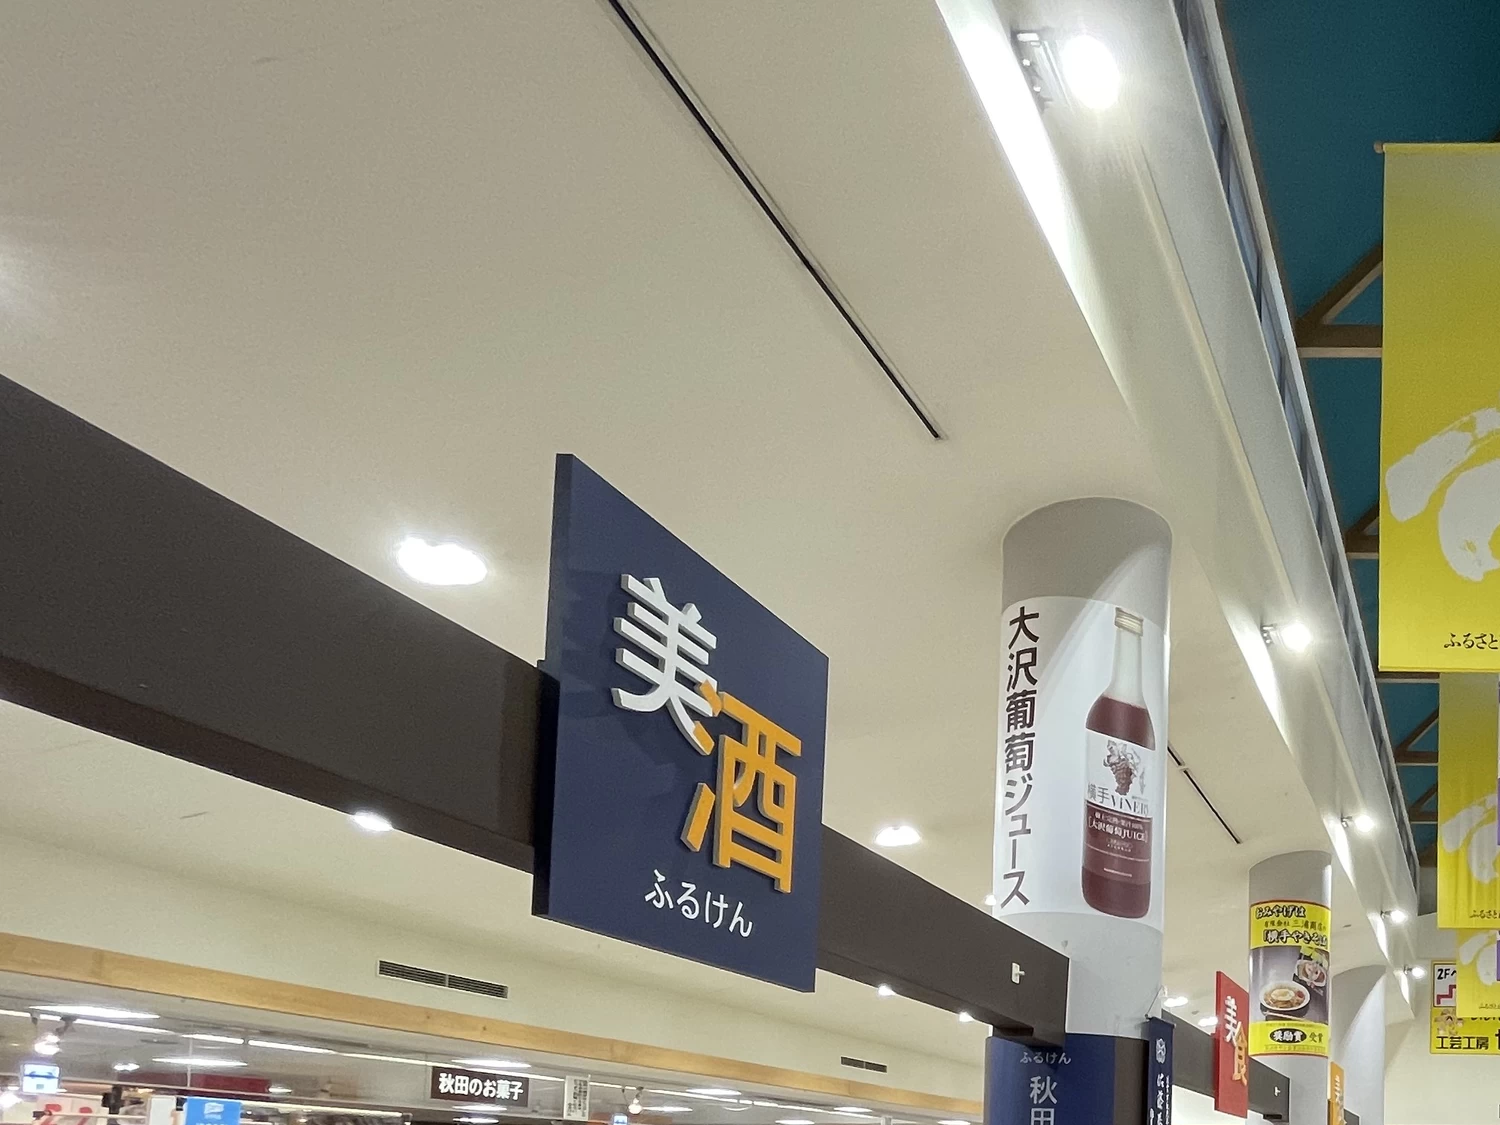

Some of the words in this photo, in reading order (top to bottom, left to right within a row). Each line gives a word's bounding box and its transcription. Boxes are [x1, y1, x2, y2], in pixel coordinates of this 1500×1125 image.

[611, 573, 801, 894] 美酒
[1001, 606, 1040, 907] 大沢葡萄ジュース
[644, 869, 753, 938] ふるけん
[1255, 904, 1307, 919] おみやげは
[1436, 1036, 1489, 1050] 工芸工房
[1020, 1051, 1073, 1065] ふるけん
[439, 1073, 523, 1100] 秋田のお菓子
